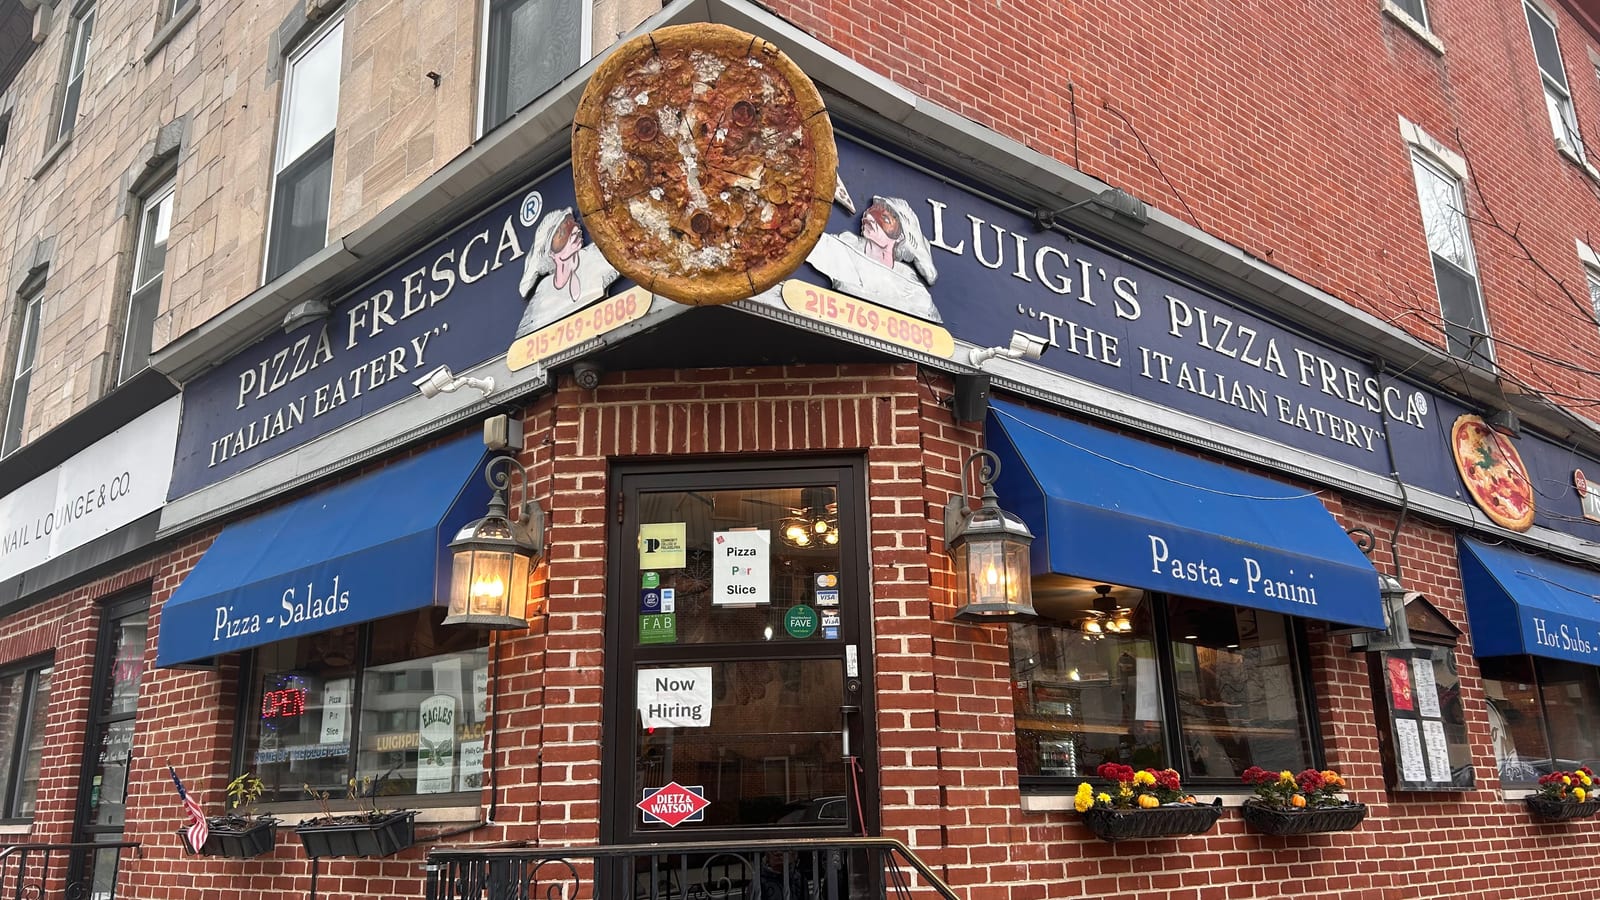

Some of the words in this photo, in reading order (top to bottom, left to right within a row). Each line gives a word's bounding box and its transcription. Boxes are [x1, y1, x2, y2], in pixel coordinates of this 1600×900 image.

[927, 198, 1141, 321] LUIGI'S
[1164, 294, 1288, 378] PIZZA
[526, 293, 637, 359] 215-769-8888
[805, 290, 934, 349] 215-769-8888
[236, 323, 334, 410] PIZZA
[1138, 346, 1268, 417] ITALIAN
[207, 395, 307, 468] ITALIAN
[1, 524, 29, 557] NAIL
[36, 489, 95, 540] LOUNGE
[97, 484, 106, 508] &
[110, 471, 130, 501] CO.
[727, 547, 756, 557] Pizza
[732, 566, 752, 575] Pr
[1148, 534, 1223, 588] Pasta
[1243, 557, 1318, 606] Panini
[213, 605, 260, 641] Pizza
[280, 575, 350, 629] Salads
[727, 585, 756, 594] Slice
[1533, 617, 1560, 648] Hot
[1560, 623, 1591, 654] Subs
[262, 688, 306, 717] OPEN
[656, 677, 695, 692] Now
[422, 706, 453, 728] EAGLES
[649, 703, 702, 720] Hiring
[651, 803, 694, 813] WATSON
[657, 794, 684, 804] DIETZ
[686, 795, 693, 803] &
